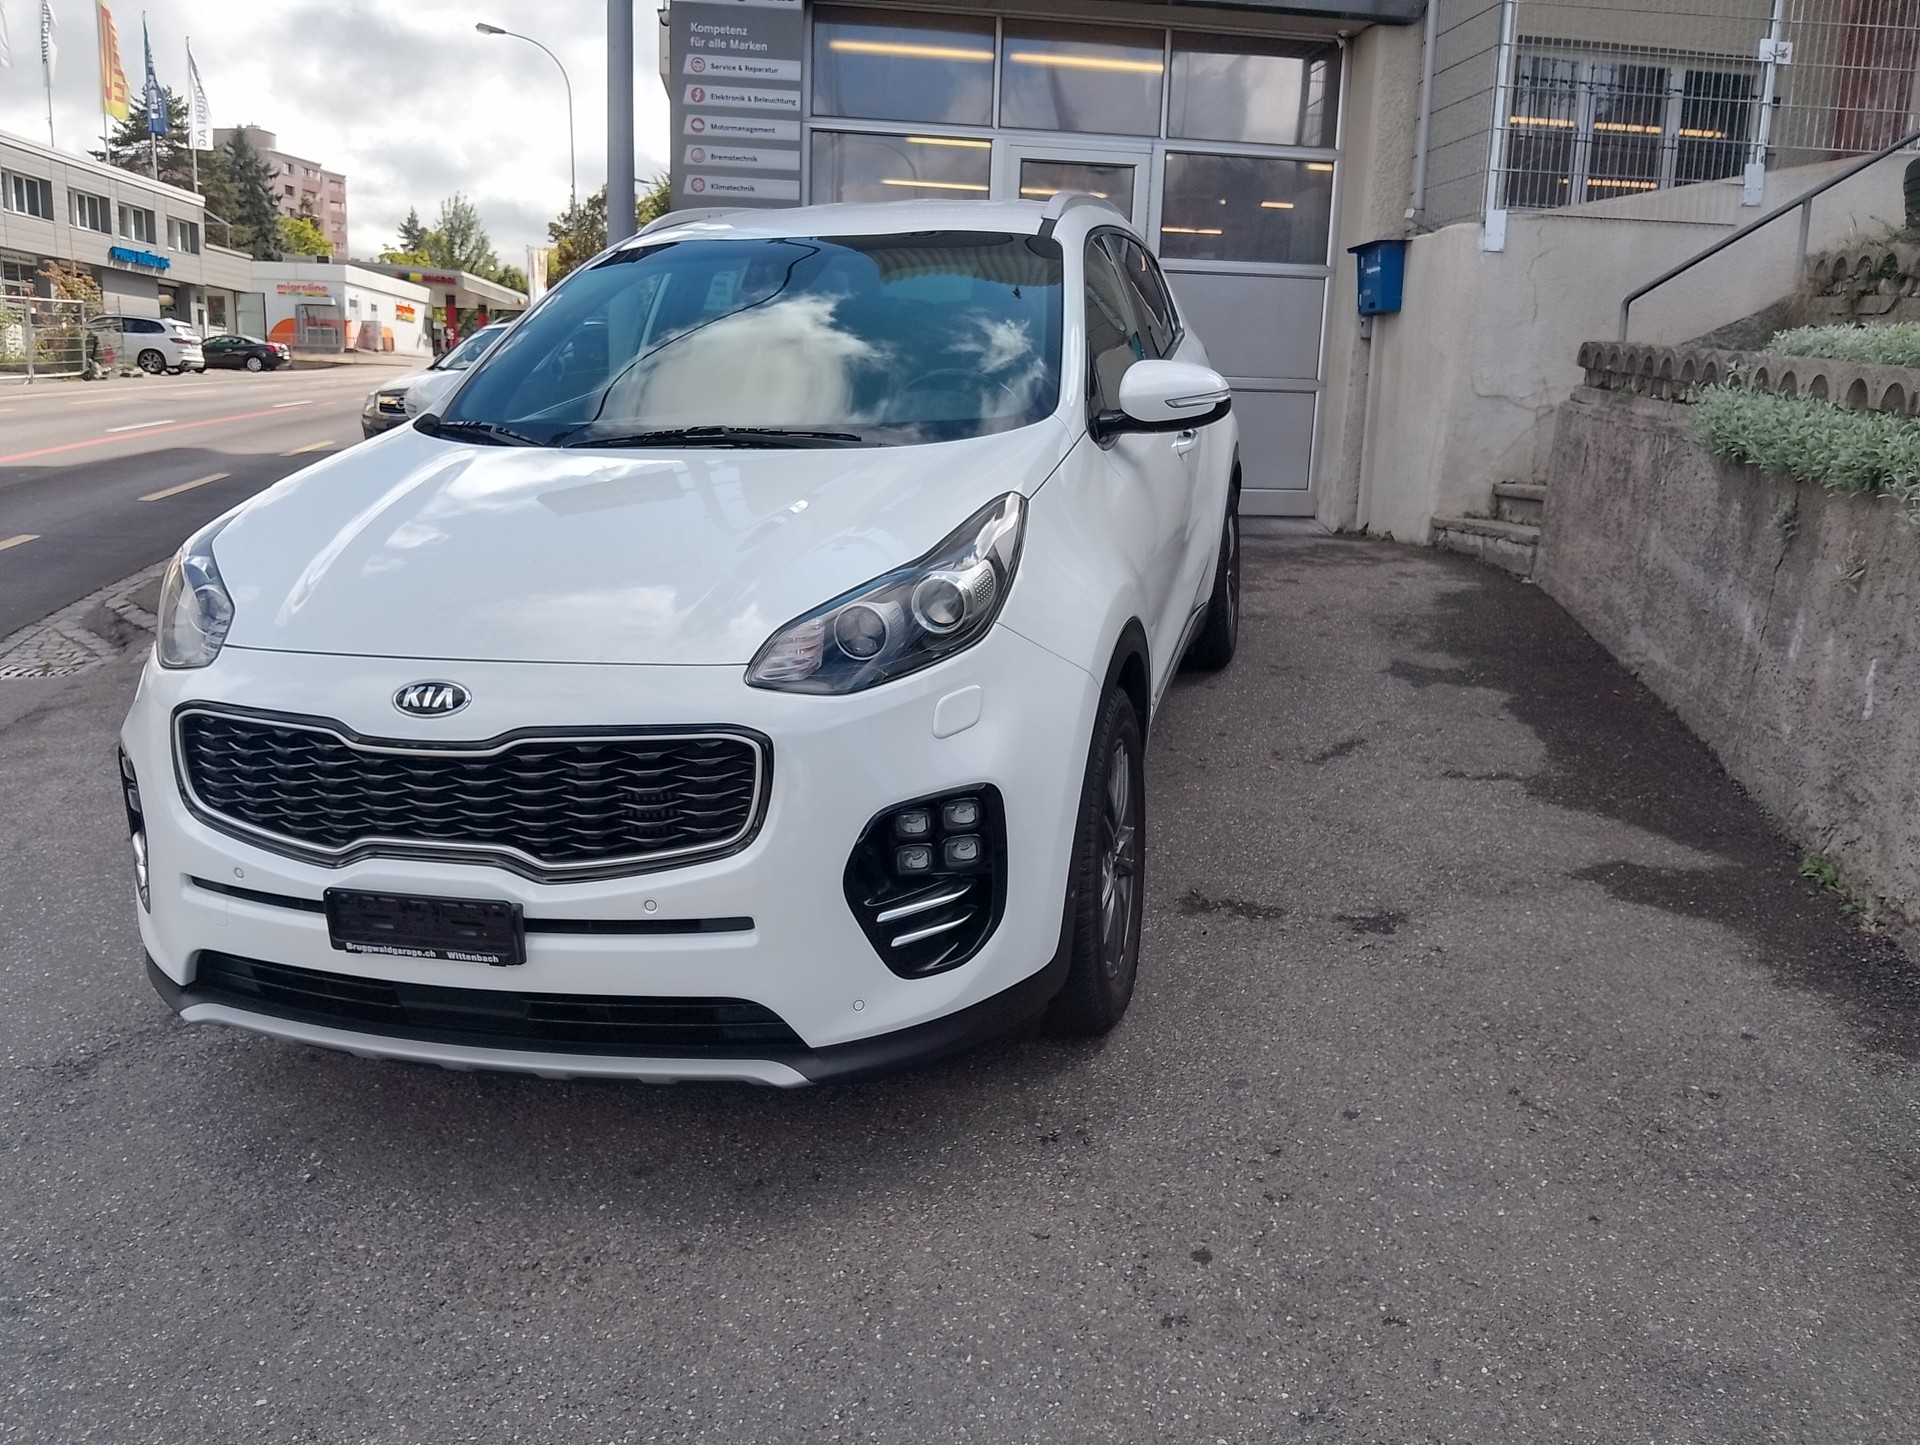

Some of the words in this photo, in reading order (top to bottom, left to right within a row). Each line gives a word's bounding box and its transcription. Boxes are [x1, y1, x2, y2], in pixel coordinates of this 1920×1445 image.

[690, 22, 748, 36] Kompetenz
[690, 36, 706, 48] für
[708, 38, 727, 49] alle
[729, 40, 768, 52] Marken
[710, 63, 736, 72] Service
[744, 65, 779, 74] Reparatur
[710, 93, 746, 102] Elektronik
[747, 95, 752, 103] &
[753, 95, 797, 106] Beleuchtung
[710, 123, 776, 135] Motormanagement
[710, 153, 759, 163] Bremstechnik
[710, 183, 756, 193] Klimatechnik
[402, 686, 454, 709] KIA
[345, 942, 437, 958] Bruggwaldgarage.ch
[446, 951, 500, 963] Wittenbach
